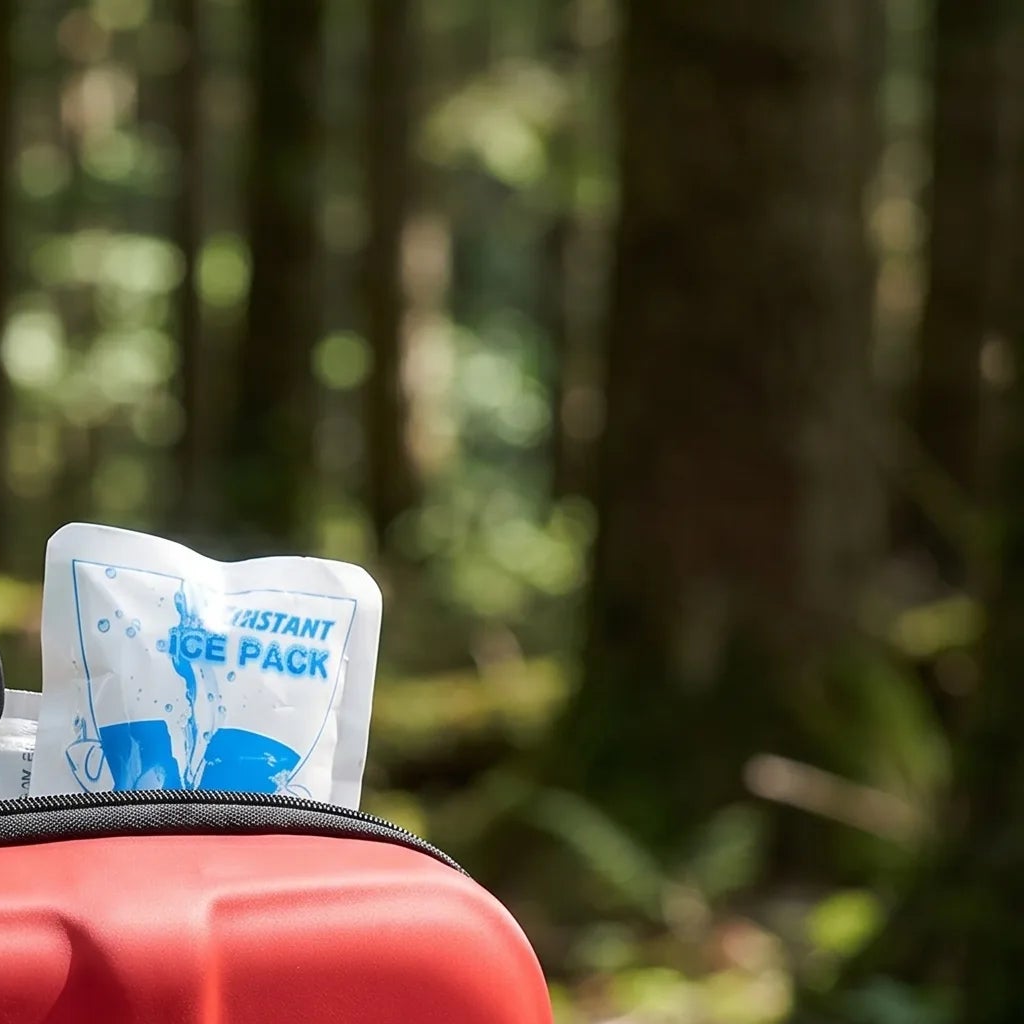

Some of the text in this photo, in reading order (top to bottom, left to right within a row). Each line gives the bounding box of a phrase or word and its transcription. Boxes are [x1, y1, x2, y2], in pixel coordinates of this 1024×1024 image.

[232, 608, 335, 641] INSTANT
[169, 630, 328, 679] ICE PACK
